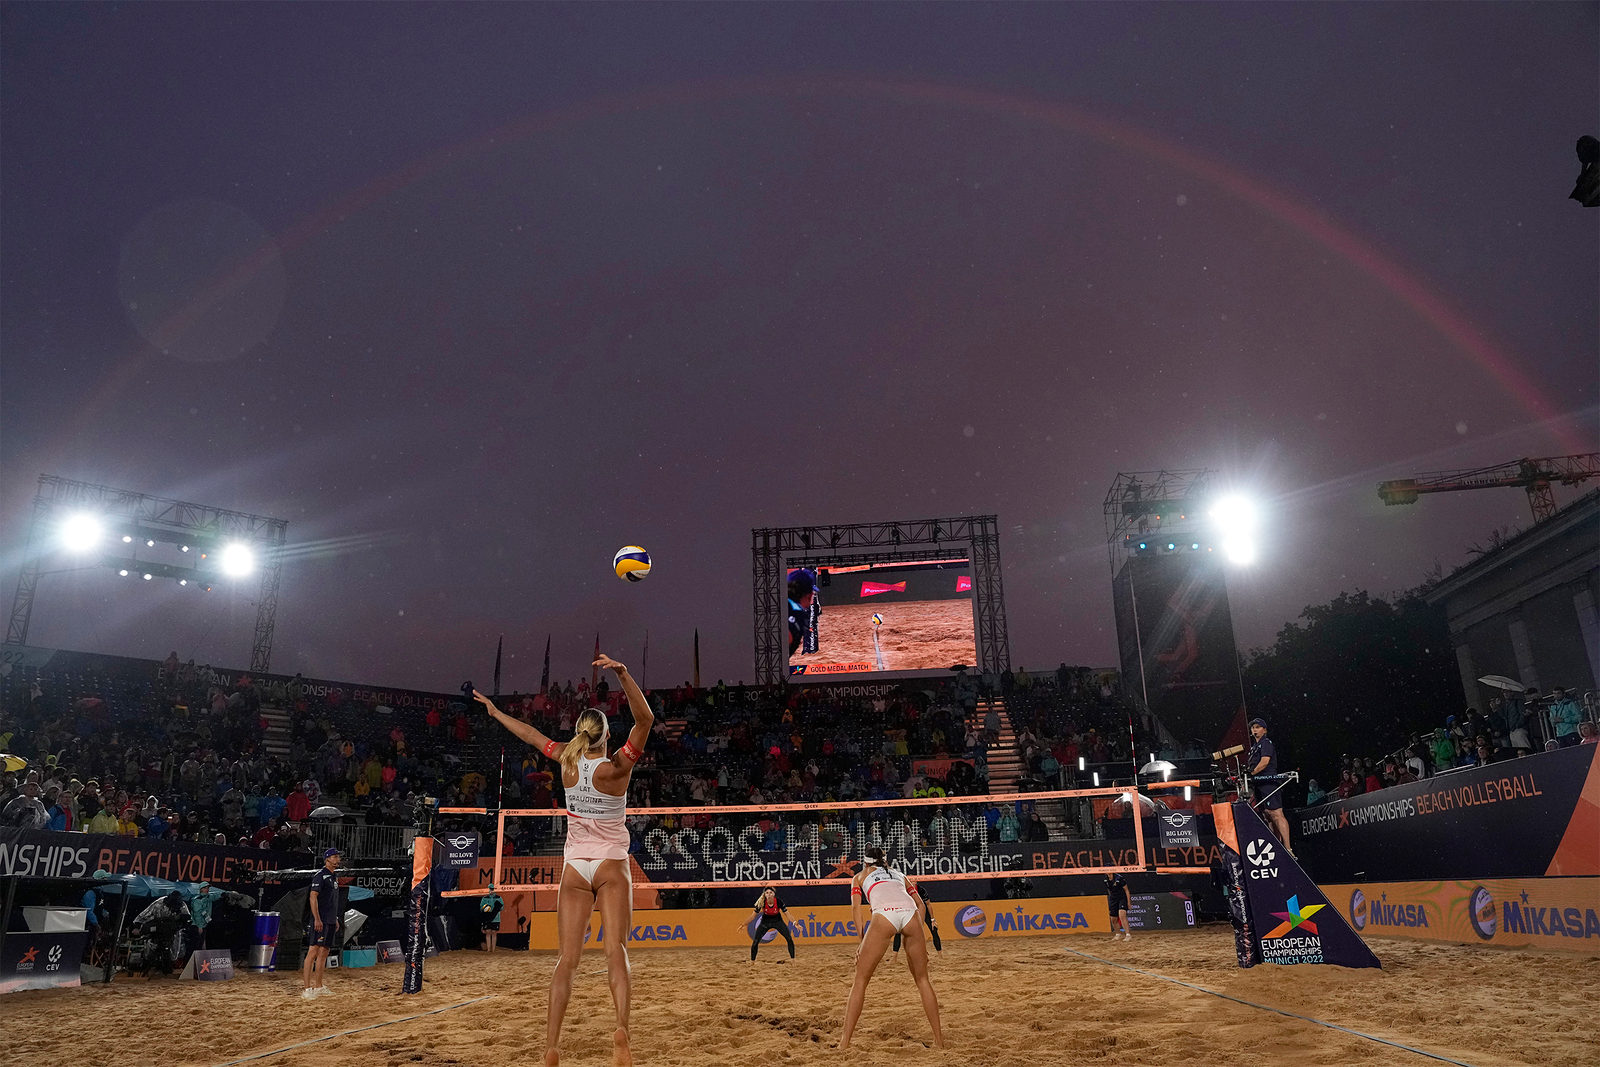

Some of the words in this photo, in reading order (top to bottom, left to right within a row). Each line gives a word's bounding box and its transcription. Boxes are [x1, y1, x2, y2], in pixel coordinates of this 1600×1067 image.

[583, 776, 588, 785] 1
[579, 785, 591, 793] LAT
[568, 794, 603, 804] GRAUDINA
[1302, 813, 1338, 836] EUROPEAN
[1349, 797, 1416, 826] CHAMPIONSHIPS
[1416, 790, 1455, 816] BEACH
[1455, 773, 1543, 808] VOLLEYBALL
[577, 807, 605, 815] Sparkasse
[97, 848, 172, 881] BEACH
[712, 860, 821, 881] EUROPEAN
[1031, 849, 1105, 869] BEACH
[1250, 867, 1279, 879] CEV
[1154, 904, 1160, 912] 2
[1185, 902, 1191, 911] 0
[1187, 914, 1193, 923] 0
[1369, 898, 1429, 928] MIKASA
[993, 910, 1089, 932] MIKASA
[1156, 916, 1162, 924] 3
[1503, 899, 1600, 939] MIKASA
[788, 915, 866, 938] MIKAS
[1261, 936, 1321, 950] EUROPEAN
[1262, 946, 1323, 958] CHAMPIONSHIPS
[1264, 956, 1300, 965] MUNICH
[1302, 954, 1324, 964] 2022
[45, 963, 60, 971] CEV
